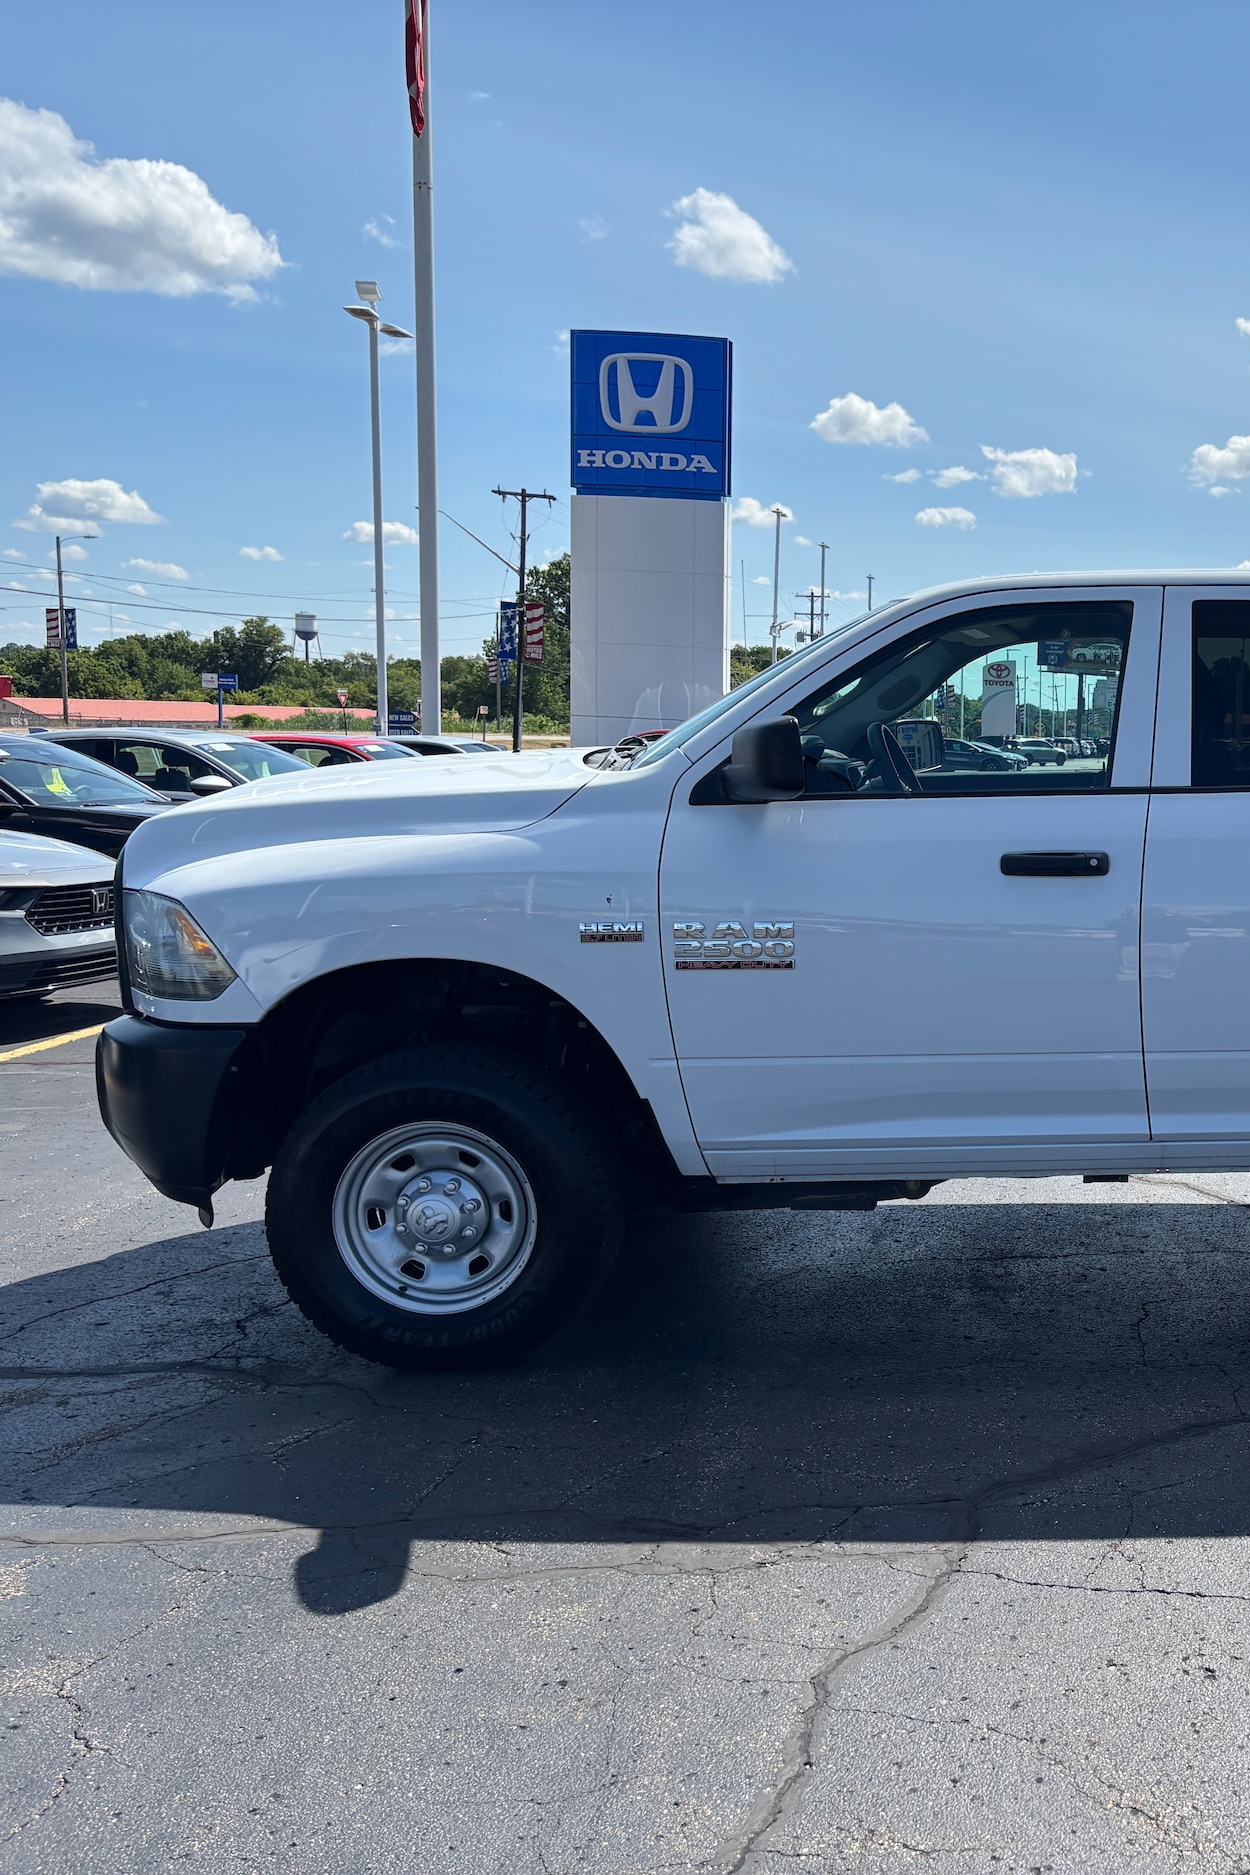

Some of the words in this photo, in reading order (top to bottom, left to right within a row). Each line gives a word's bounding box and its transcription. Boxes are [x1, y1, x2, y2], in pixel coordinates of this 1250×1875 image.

[577, 449, 718, 473] HONDA
[578, 921, 643, 933] HEMI
[673, 921, 795, 938] RAM
[673, 939, 795, 958] 2500
[678, 960, 737, 970] HEAVY
[740, 960, 790, 970] DUTY
